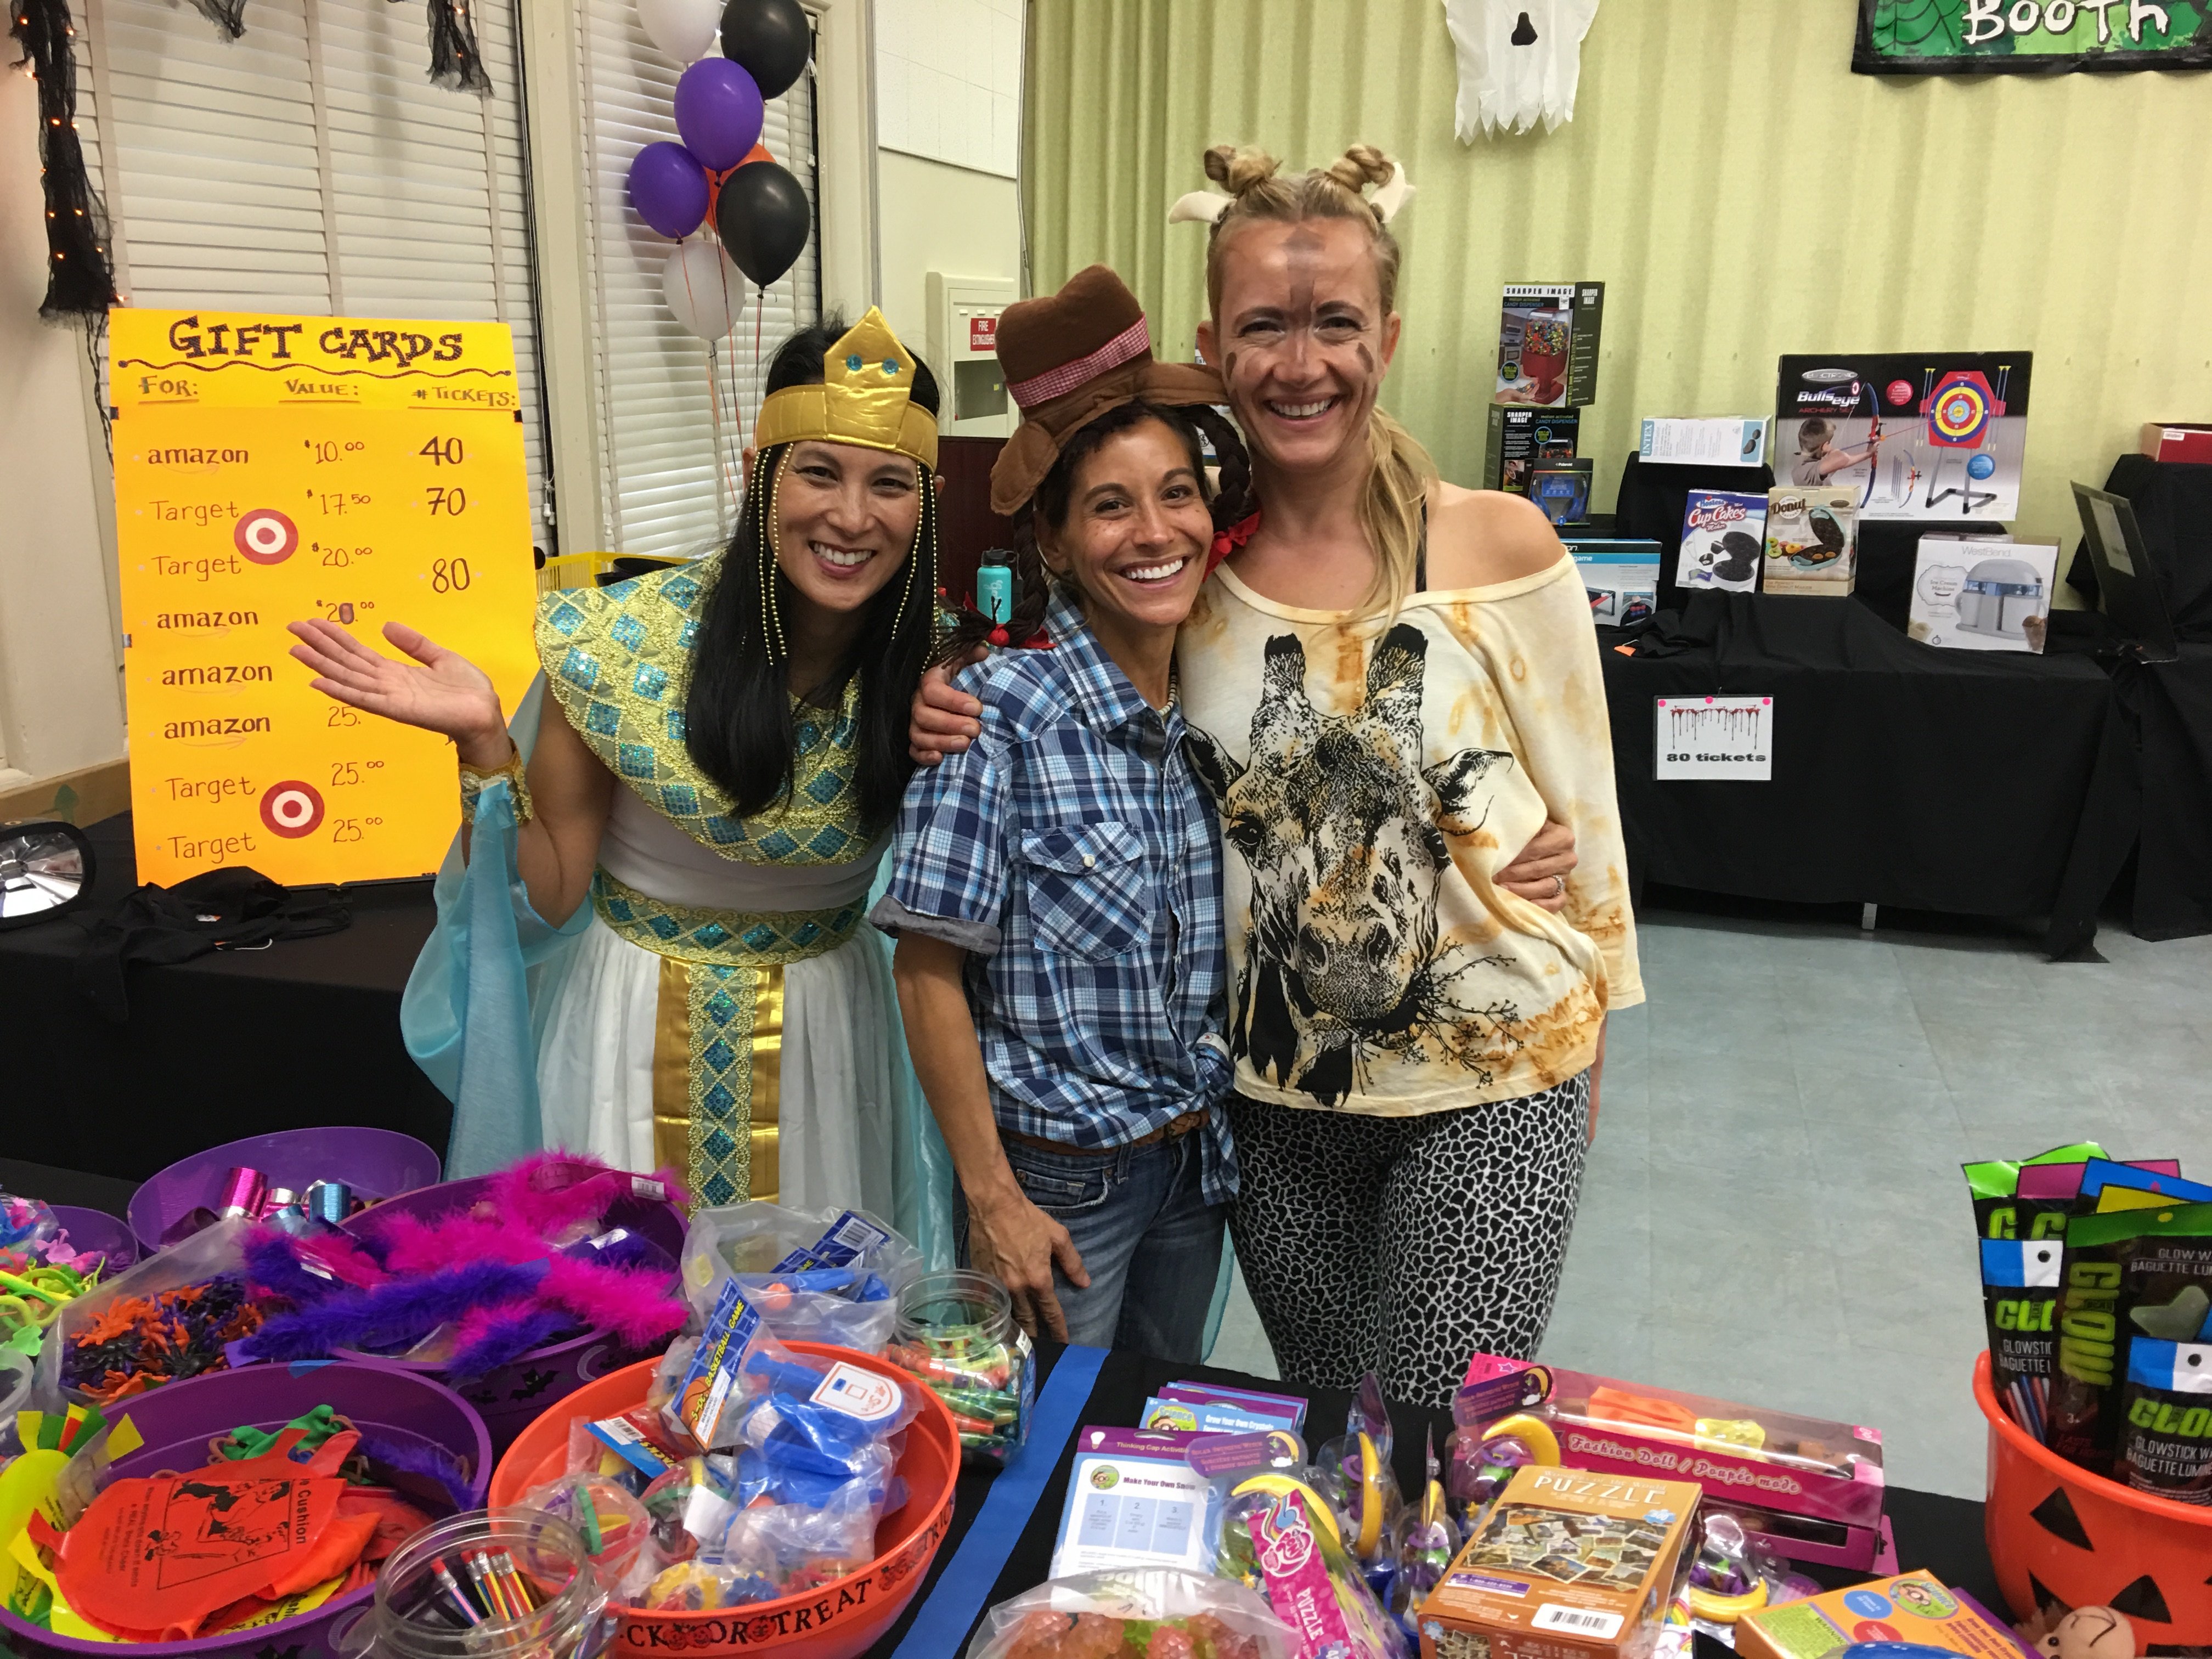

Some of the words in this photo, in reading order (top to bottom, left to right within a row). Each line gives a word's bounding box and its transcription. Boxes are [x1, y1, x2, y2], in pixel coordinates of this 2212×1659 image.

[168, 314, 303, 359] GIFT
[319, 326, 462, 368] CARDS
[138, 376, 199, 397] FOR:
[284, 379, 360, 397] VALUE:
[411, 388, 428, 400] #
[431, 386, 516, 409] TICKETS:
[148, 447, 249, 465] amazon
[419, 436, 464, 466] 40
[1643, 424, 1652, 454] INTEX
[149, 499, 240, 527] Target
[426, 487, 466, 516] 70
[1771, 498, 1806, 515] Donut
[151, 554, 242, 582] Target
[431, 557, 471, 594] 80
[157, 610, 259, 630] amazon
[162, 664, 273, 686] amazon
[164, 716, 270, 740] amazon
[1667, 753, 1690, 762] 80
[1696, 753, 1767, 762] tickets
[165, 776, 256, 803] Target
[168, 832, 256, 864] Target
[2131, 1261, 2189, 1274] BAGUETTE
[705, 1331, 730, 1387] BASKETBALL
[729, 1299, 744, 1329] GAME
[1158, 1406, 1194, 1423] Science
[1235, 1419, 1248, 1427] Own
[1117, 1442, 1145, 1451] Thinking
[2135, 1435, 2198, 1460] GLOWSTICK
[1570, 1434, 1634, 1460] Fashion
[1638, 1449, 1677, 1469] Doll
[1694, 1461, 1753, 1484] Poupée
[1758, 1477, 1799, 1493] mode
[2126, 1447, 2176, 1476] BAGUETTE
[1143, 1479, 1159, 1487] Your
[1160, 1480, 1175, 1489] Own
[1176, 1482, 1196, 1491] Snow
[1534, 1476, 1666, 1505] PUZZLE
[296, 1489, 312, 1545] Cushion
[707, 1620, 748, 1645] OR
[774, 1578, 872, 1637] TREAT
[1296, 1587, 1324, 1641] PUZZLE
